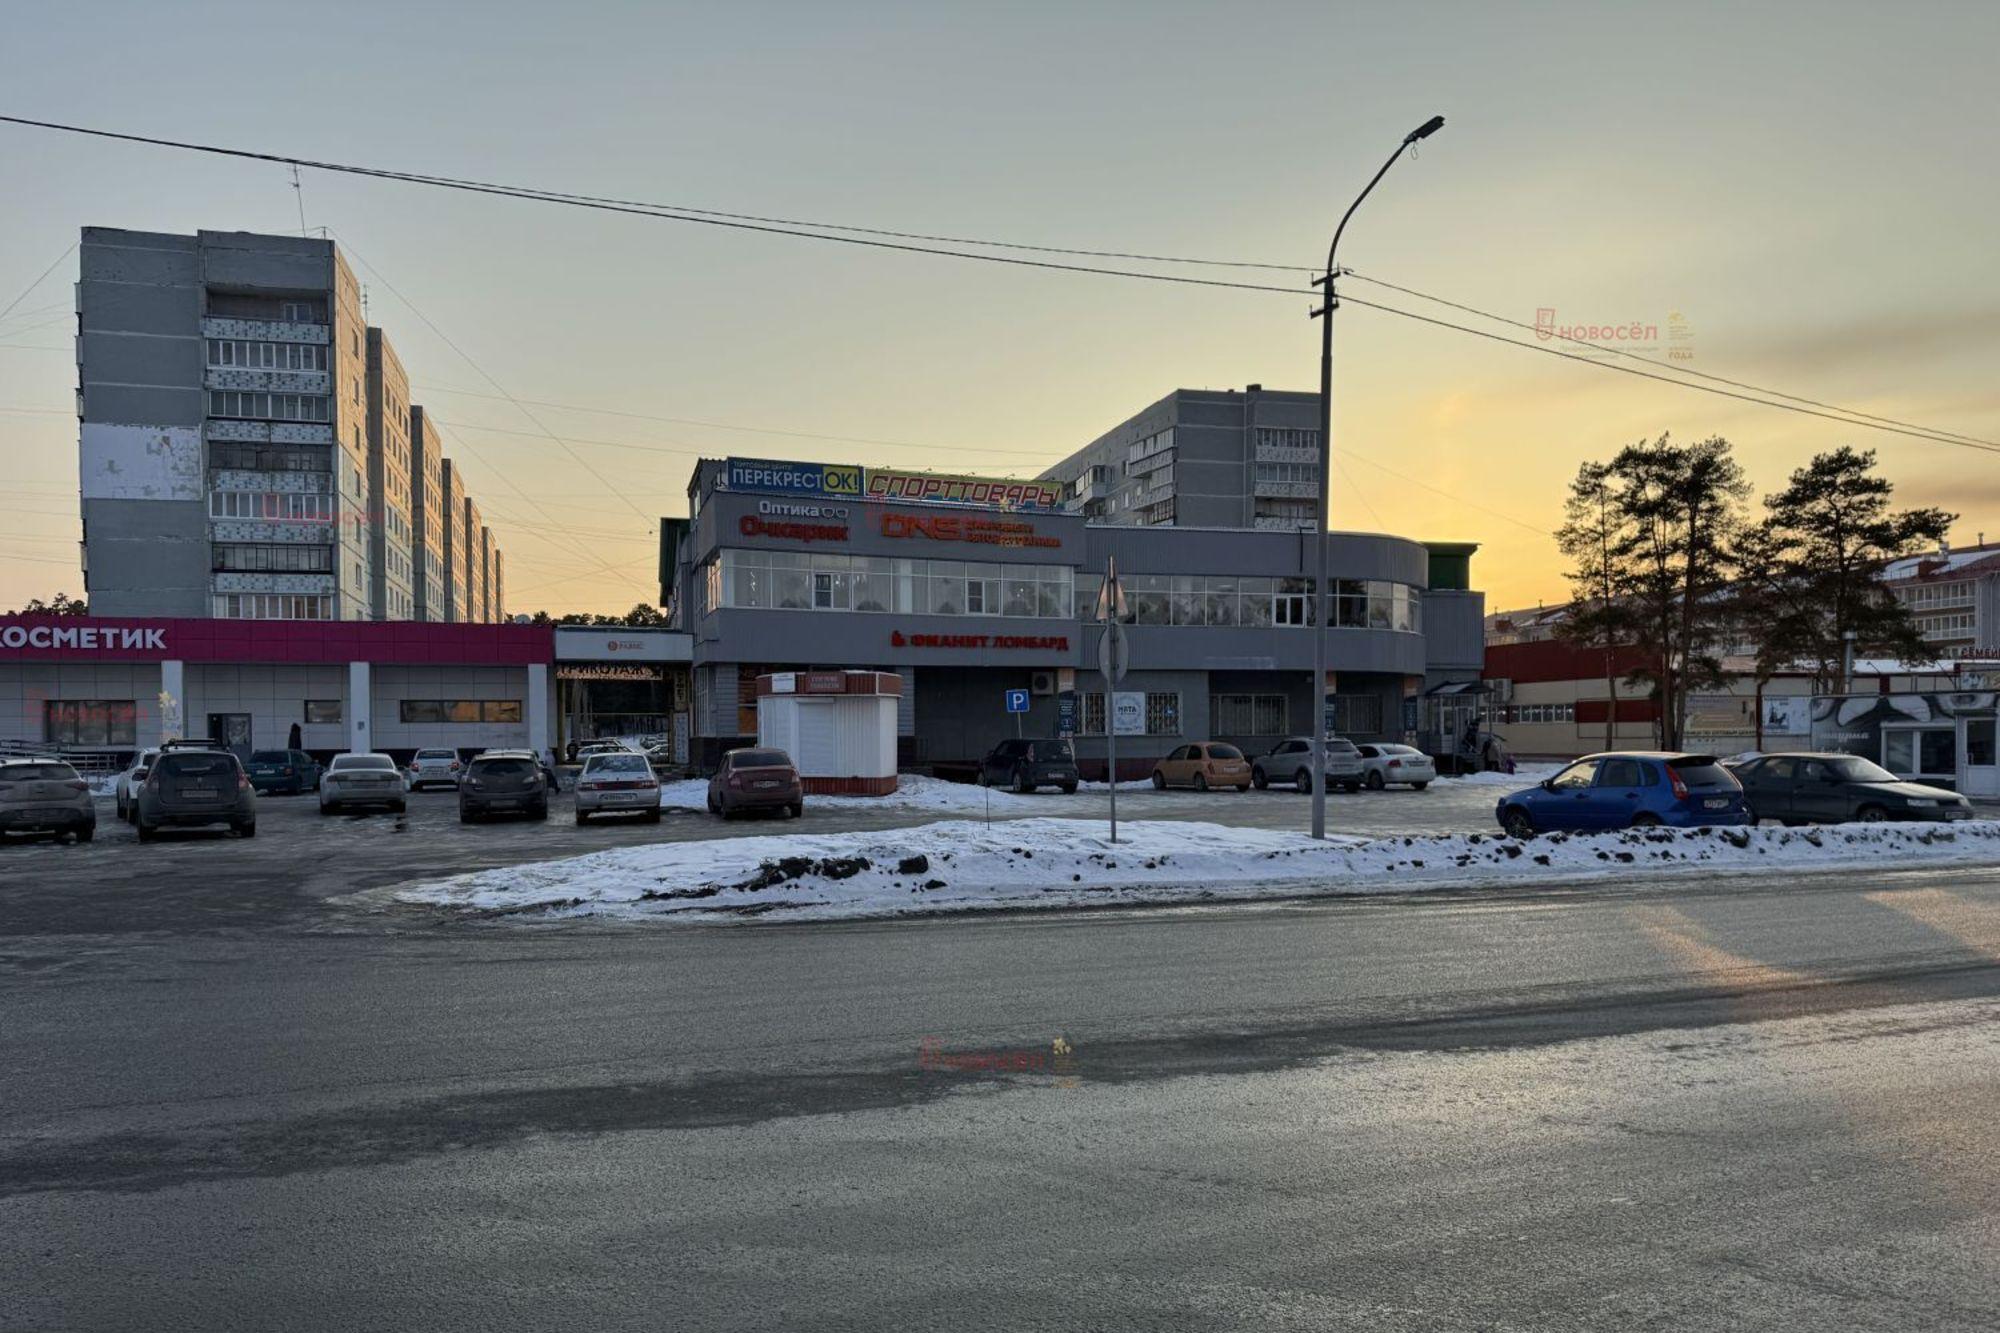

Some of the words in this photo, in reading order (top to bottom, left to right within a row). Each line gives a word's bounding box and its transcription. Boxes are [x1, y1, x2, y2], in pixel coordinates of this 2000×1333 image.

[868, 475, 1061, 507] СПОРТТОВАРЫ
[759, 500, 820, 517] Оптика
[0, 626, 168, 649] ОСМЕТИК
[910, 633, 989, 648] ФИАНИТ
[993, 635, 1069, 651] ЛОМБАРД
